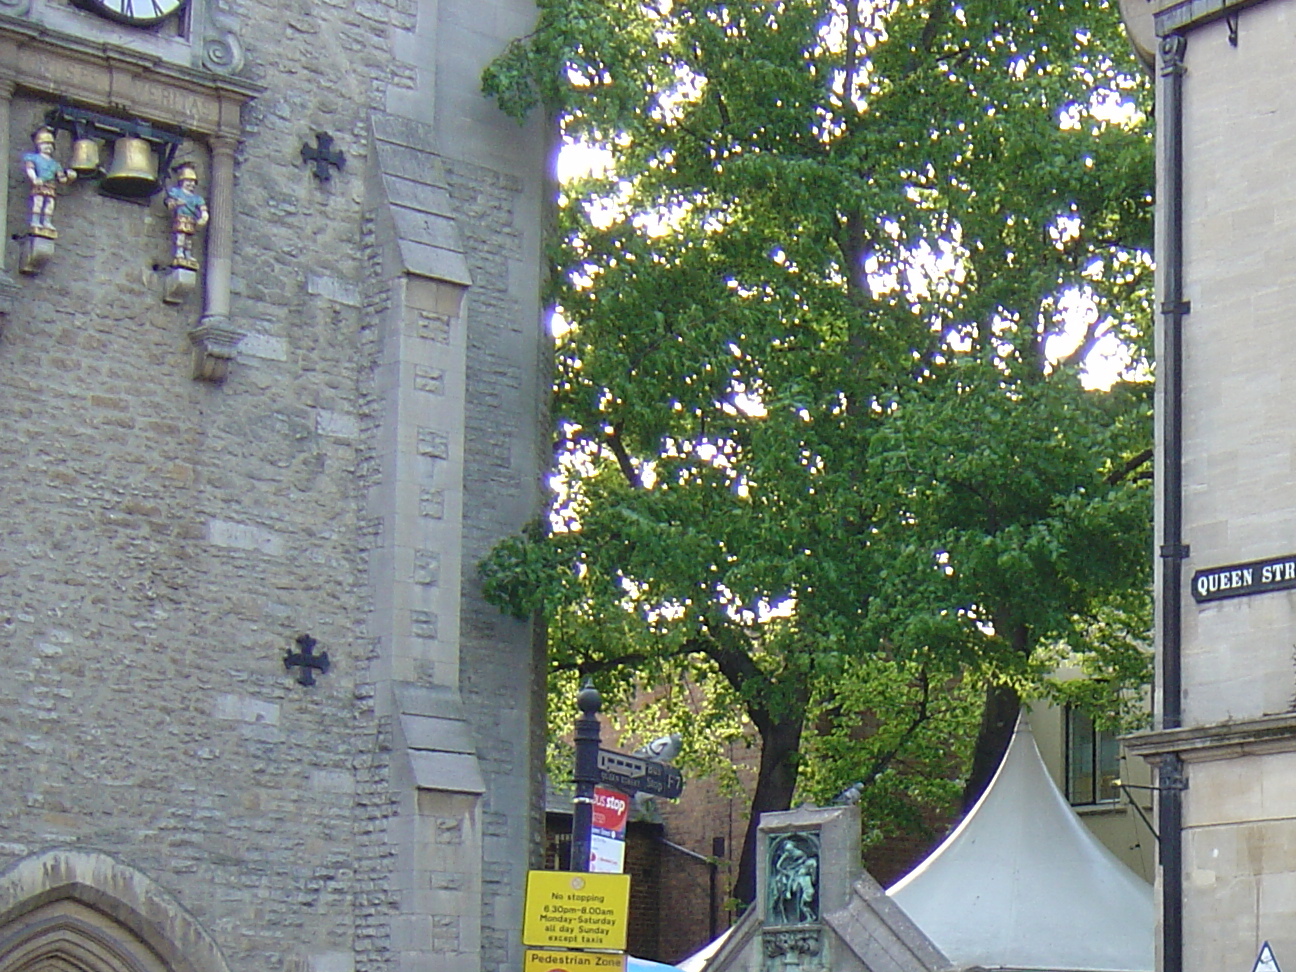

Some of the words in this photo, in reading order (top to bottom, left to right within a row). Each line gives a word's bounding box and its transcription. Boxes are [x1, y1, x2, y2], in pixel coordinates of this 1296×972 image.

[1197, 568, 1253, 596] QUEEN
[667, 774, 681, 790] F7
[606, 796, 626, 816] stop
[551, 892, 564, 900] No
[567, 894, 605, 904] stopping
[540, 914, 617, 927] Monday-Saturday
[545, 924, 556, 932] all
[559, 925, 575, 934] day
[578, 925, 610, 936] Sunday
[548, 935, 578, 943] except
[581, 936, 603, 944] taxis
[531, 953, 591, 966] Pedestrian
[594, 956, 621, 967] Zone
